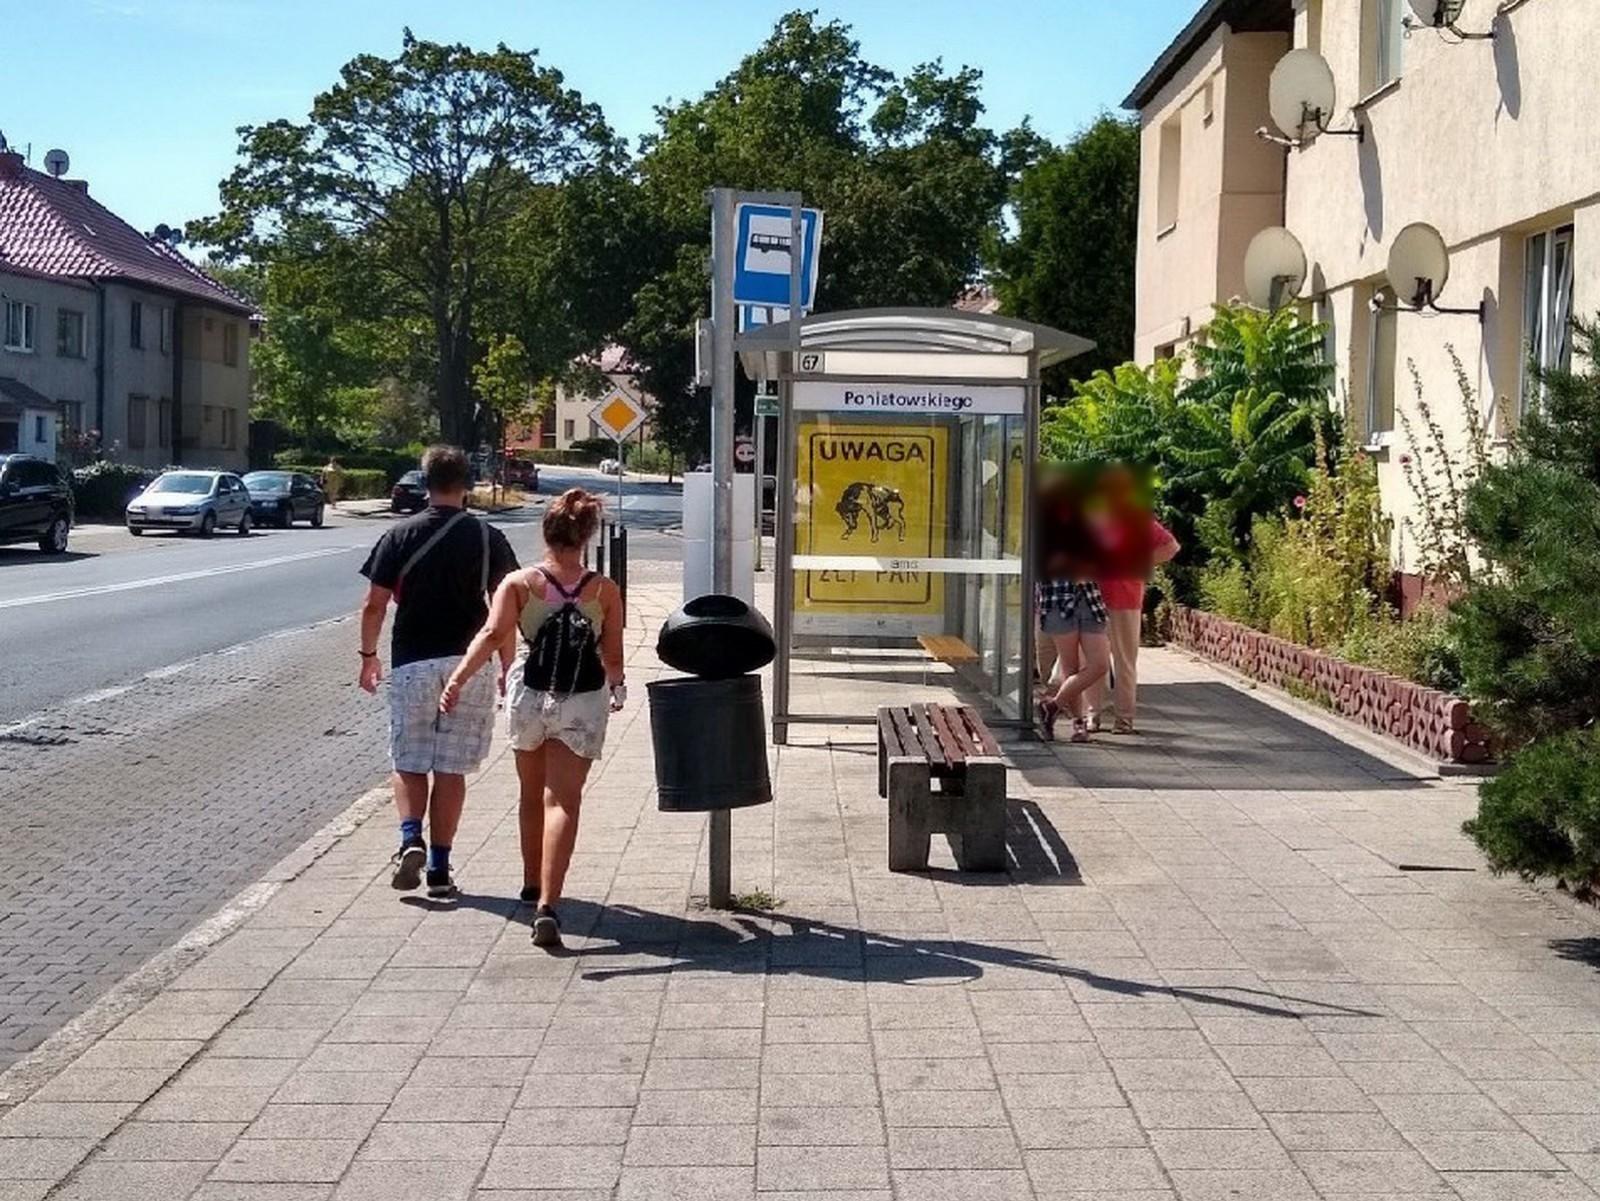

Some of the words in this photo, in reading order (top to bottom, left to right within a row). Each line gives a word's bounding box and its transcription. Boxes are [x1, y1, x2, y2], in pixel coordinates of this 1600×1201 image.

[802, 355, 819, 370] 67
[844, 391, 973, 410] Poniatowskiego
[819, 441, 925, 462] UWAGA
